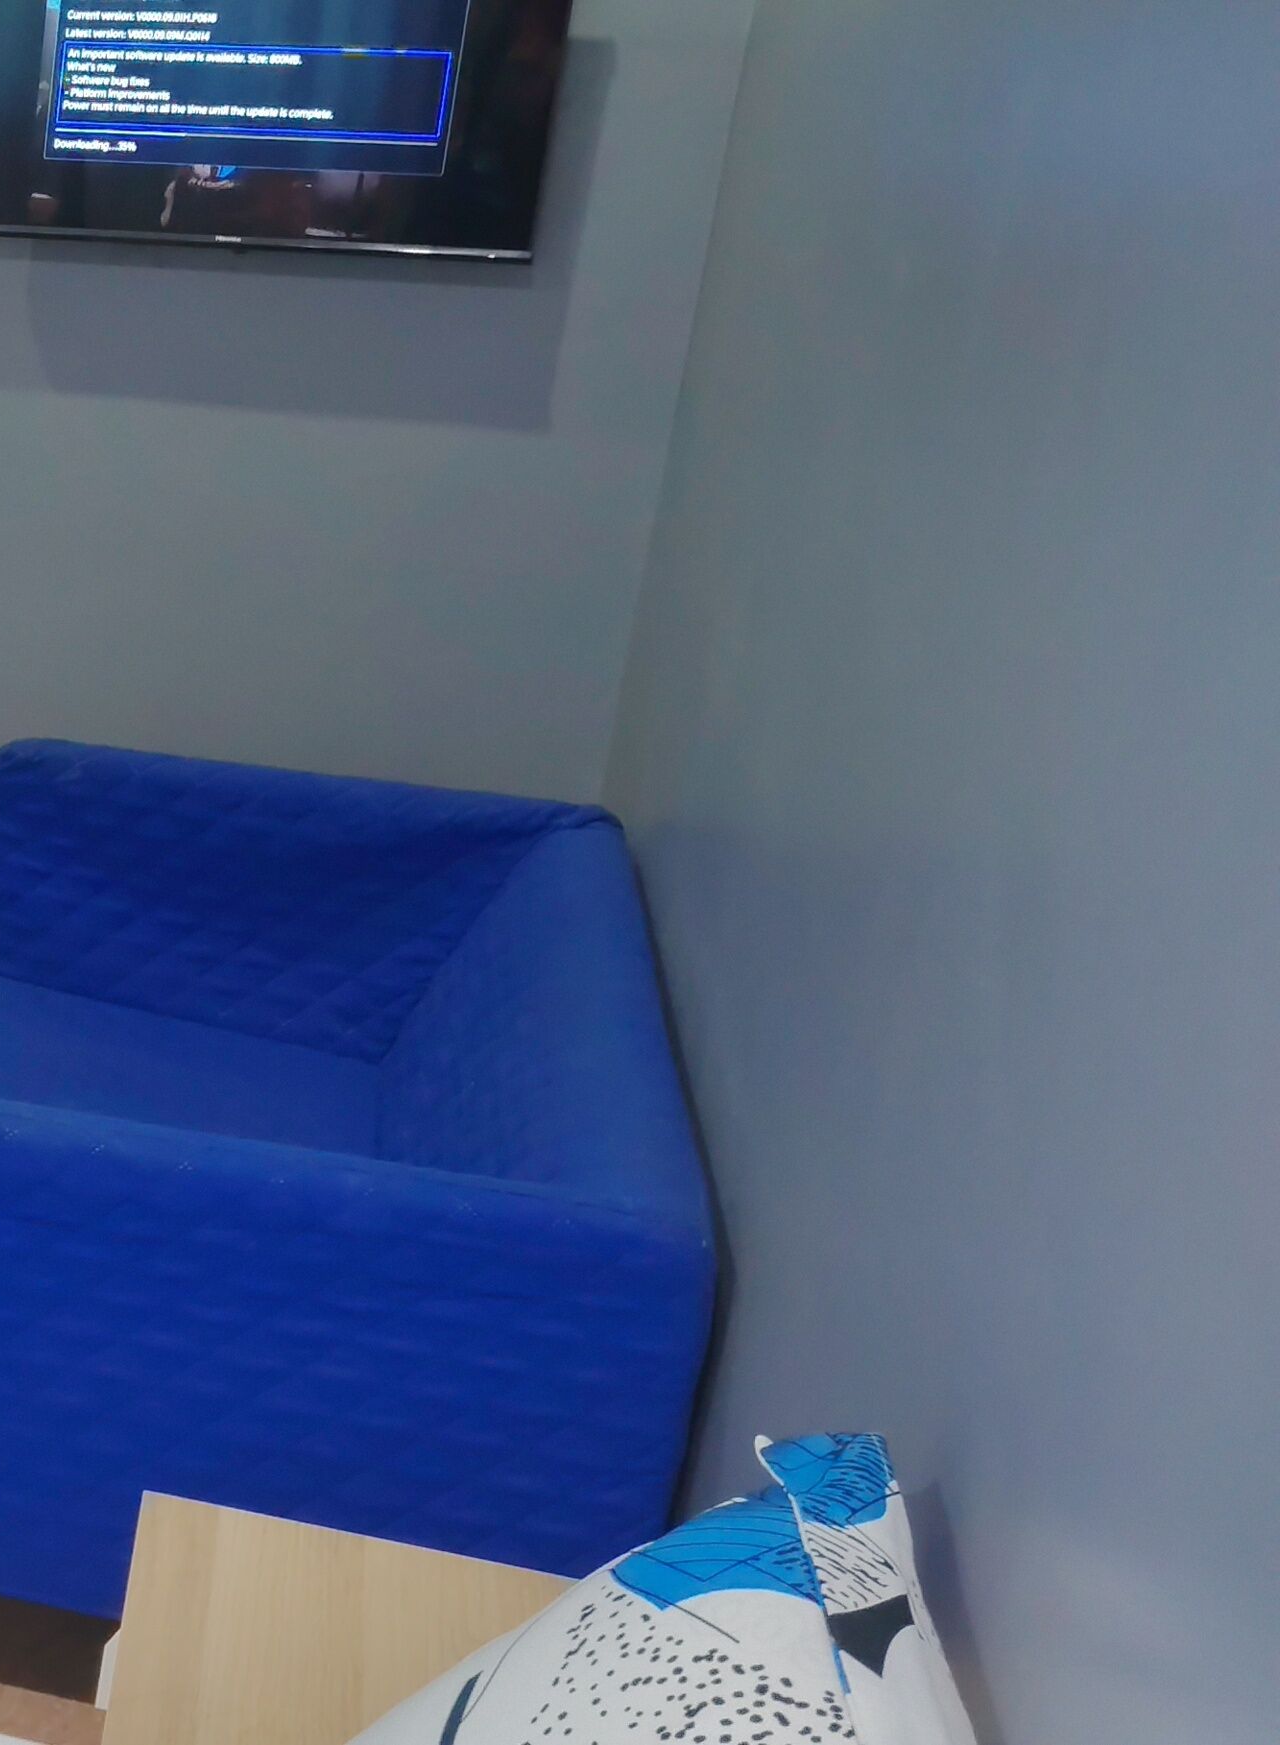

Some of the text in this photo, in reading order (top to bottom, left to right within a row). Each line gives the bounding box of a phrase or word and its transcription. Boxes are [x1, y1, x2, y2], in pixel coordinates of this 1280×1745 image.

[67, 10, 100, 21] Current
[101, 11, 135, 22] version:
[65, 28, 91, 38] Latest
[93, 28, 126, 39] version:
[68, 48, 80, 59] An
[81, 48, 124, 60] important
[125, 50, 163, 60] software
[164, 51, 196, 62] update
[197, 51, 205, 62] is
[67, 61, 116, 72] What's new
[71, 75, 110, 85] Software
[111, 76, 128, 88] bug
[129, 76, 150, 87] fixes
[70, 88, 107, 98] Platform
[108, 88, 171, 101] improvements
[62, 100, 90, 110] Power
[91, 101, 113, 112] must
[114, 102, 145, 112] remain
[146, 104, 159, 113] on
[159, 103, 170, 113] all
[171, 103, 186, 114] the
[187, 104, 208, 115] time
[209, 104, 230, 116] until
[230, 105, 245, 116] the
[246, 106, 279, 118] update
[279, 107, 288, 118] is
